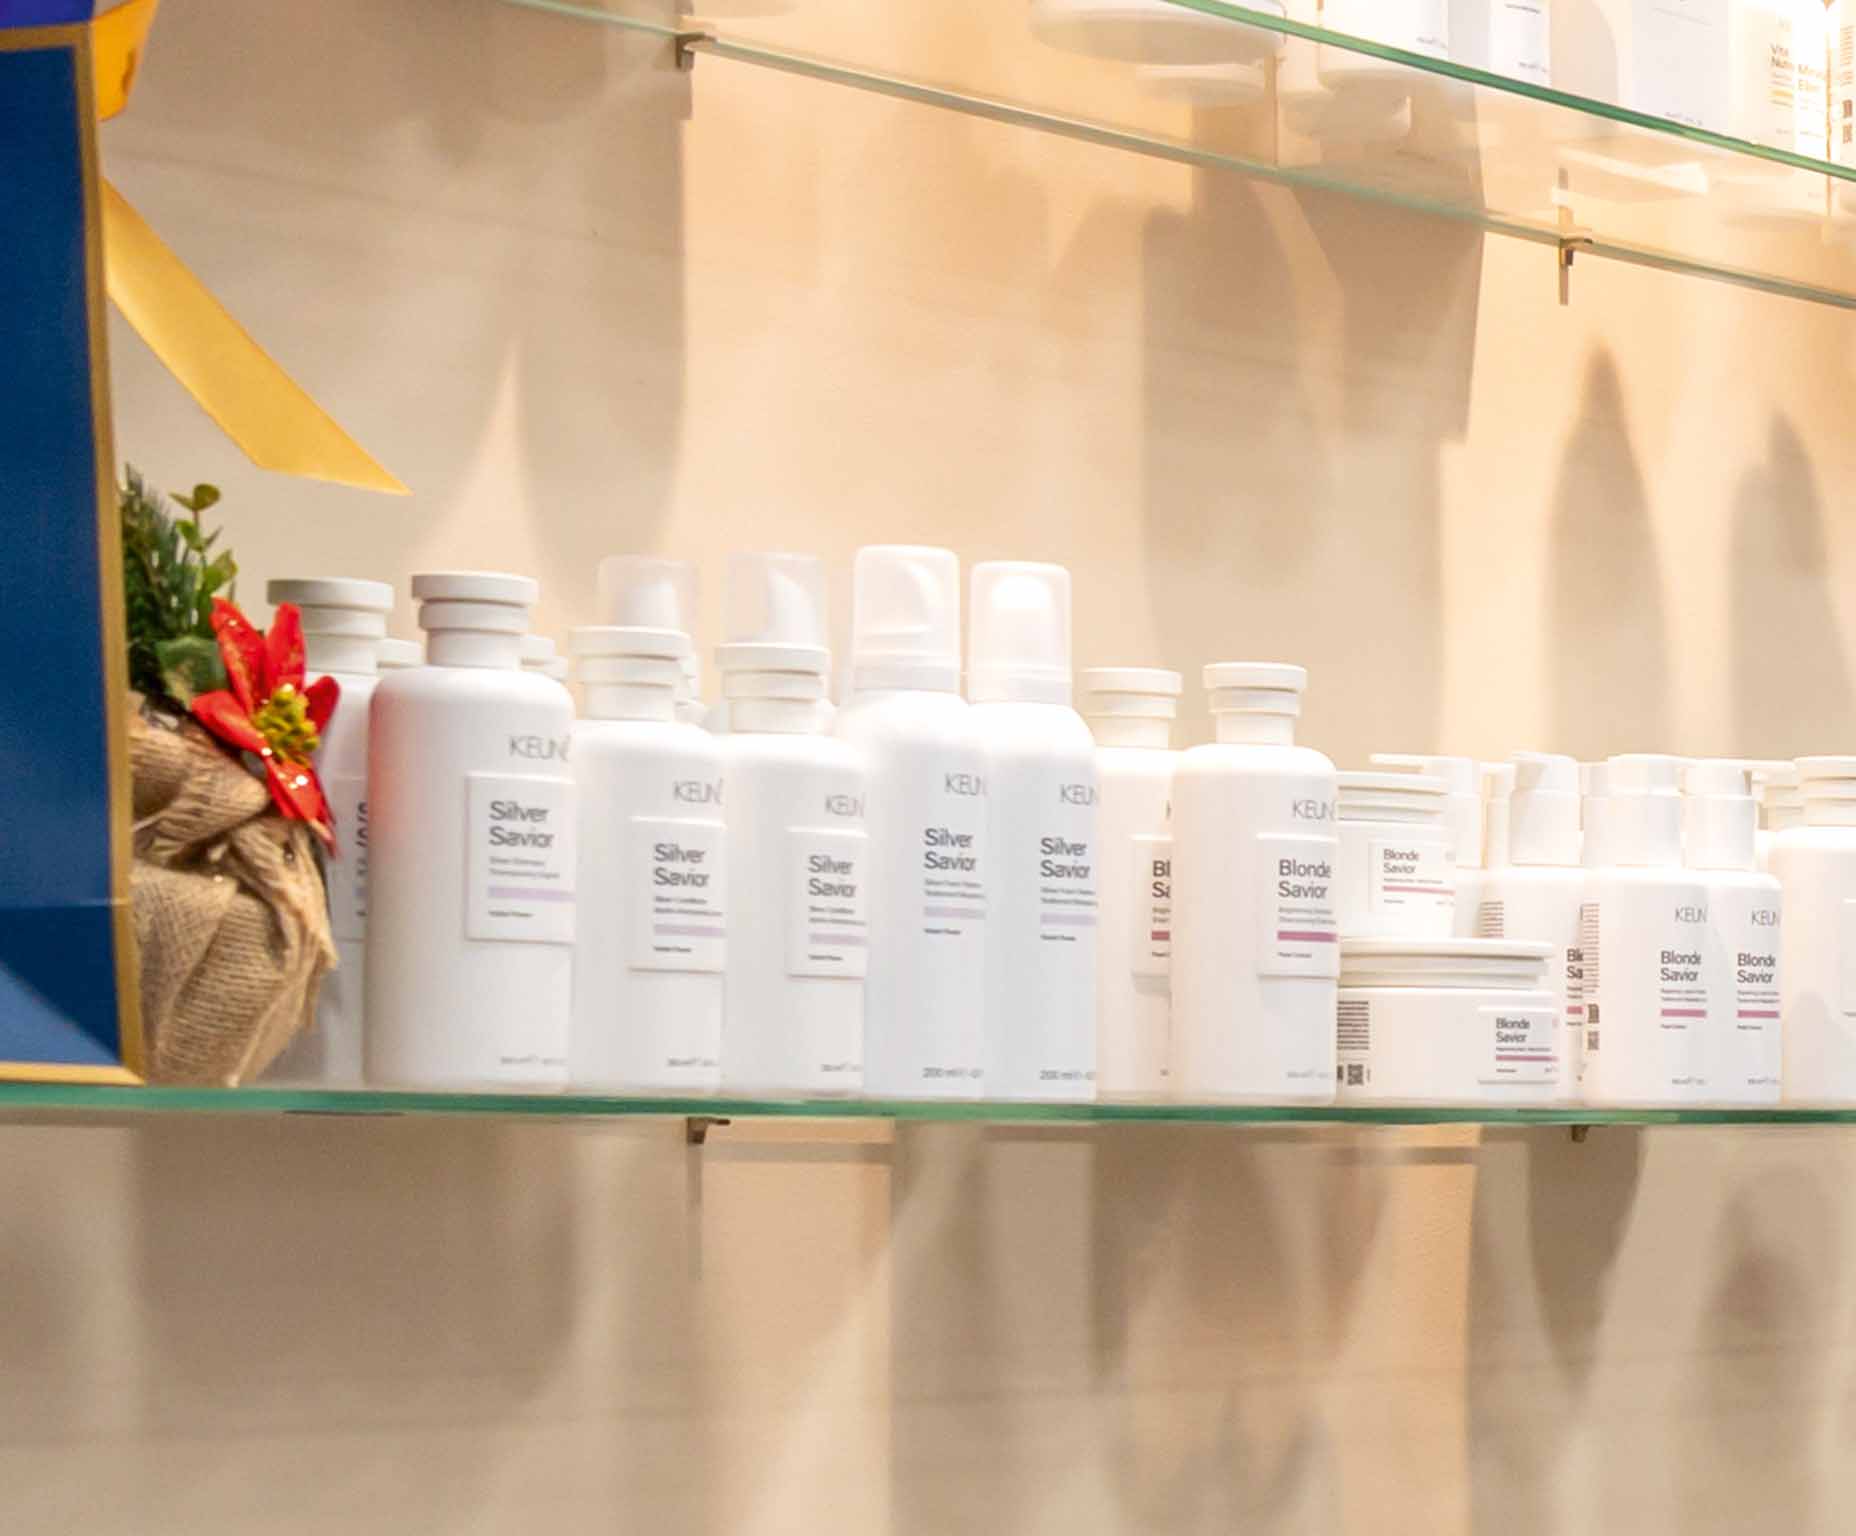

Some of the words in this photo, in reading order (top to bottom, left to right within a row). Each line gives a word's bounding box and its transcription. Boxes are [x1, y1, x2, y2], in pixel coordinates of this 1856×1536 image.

[489, 800, 548, 823] Silver
[489, 826, 553, 849] Savior
[924, 828, 973, 849] Silver
[1040, 837, 1087, 857] Silver
[654, 843, 704, 864] Silver
[924, 851, 976, 872] Savior
[1383, 849, 1420, 862] Blonde
[808, 855, 853, 876] Silver
[1040, 860, 1090, 880] Savior
[1279, 859, 1331, 878] Blonde
[654, 867, 709, 887] Savior
[808, 878, 855, 898] Savior
[1278, 881, 1328, 899] Savior
[1661, 967, 1698, 983] Savior
[1737, 969, 1773, 984] Savior
[1496, 1018, 1531, 1031] Blonde
